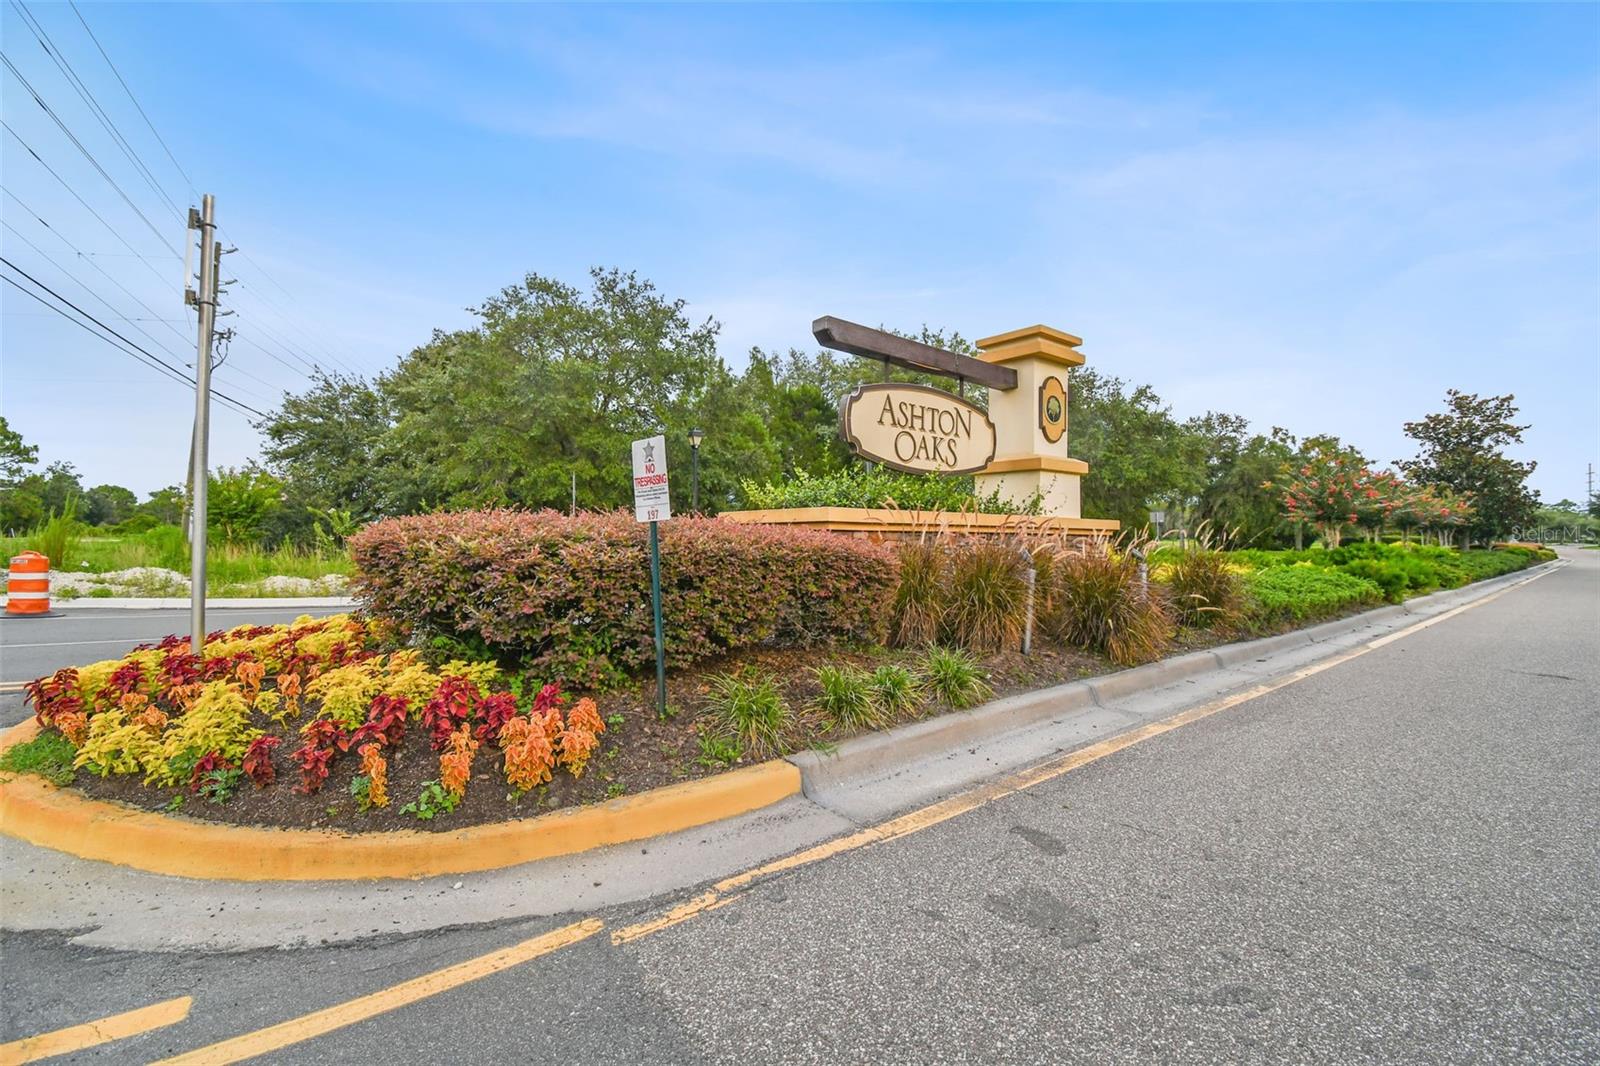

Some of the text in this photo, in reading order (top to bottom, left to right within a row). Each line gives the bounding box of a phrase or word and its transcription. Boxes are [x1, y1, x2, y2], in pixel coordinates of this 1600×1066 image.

[877, 393, 971, 439] ASHTON
[894, 430, 958, 469] OAKS
[634, 473, 667, 487] TRESPASSING
[645, 463, 656, 474] NO
